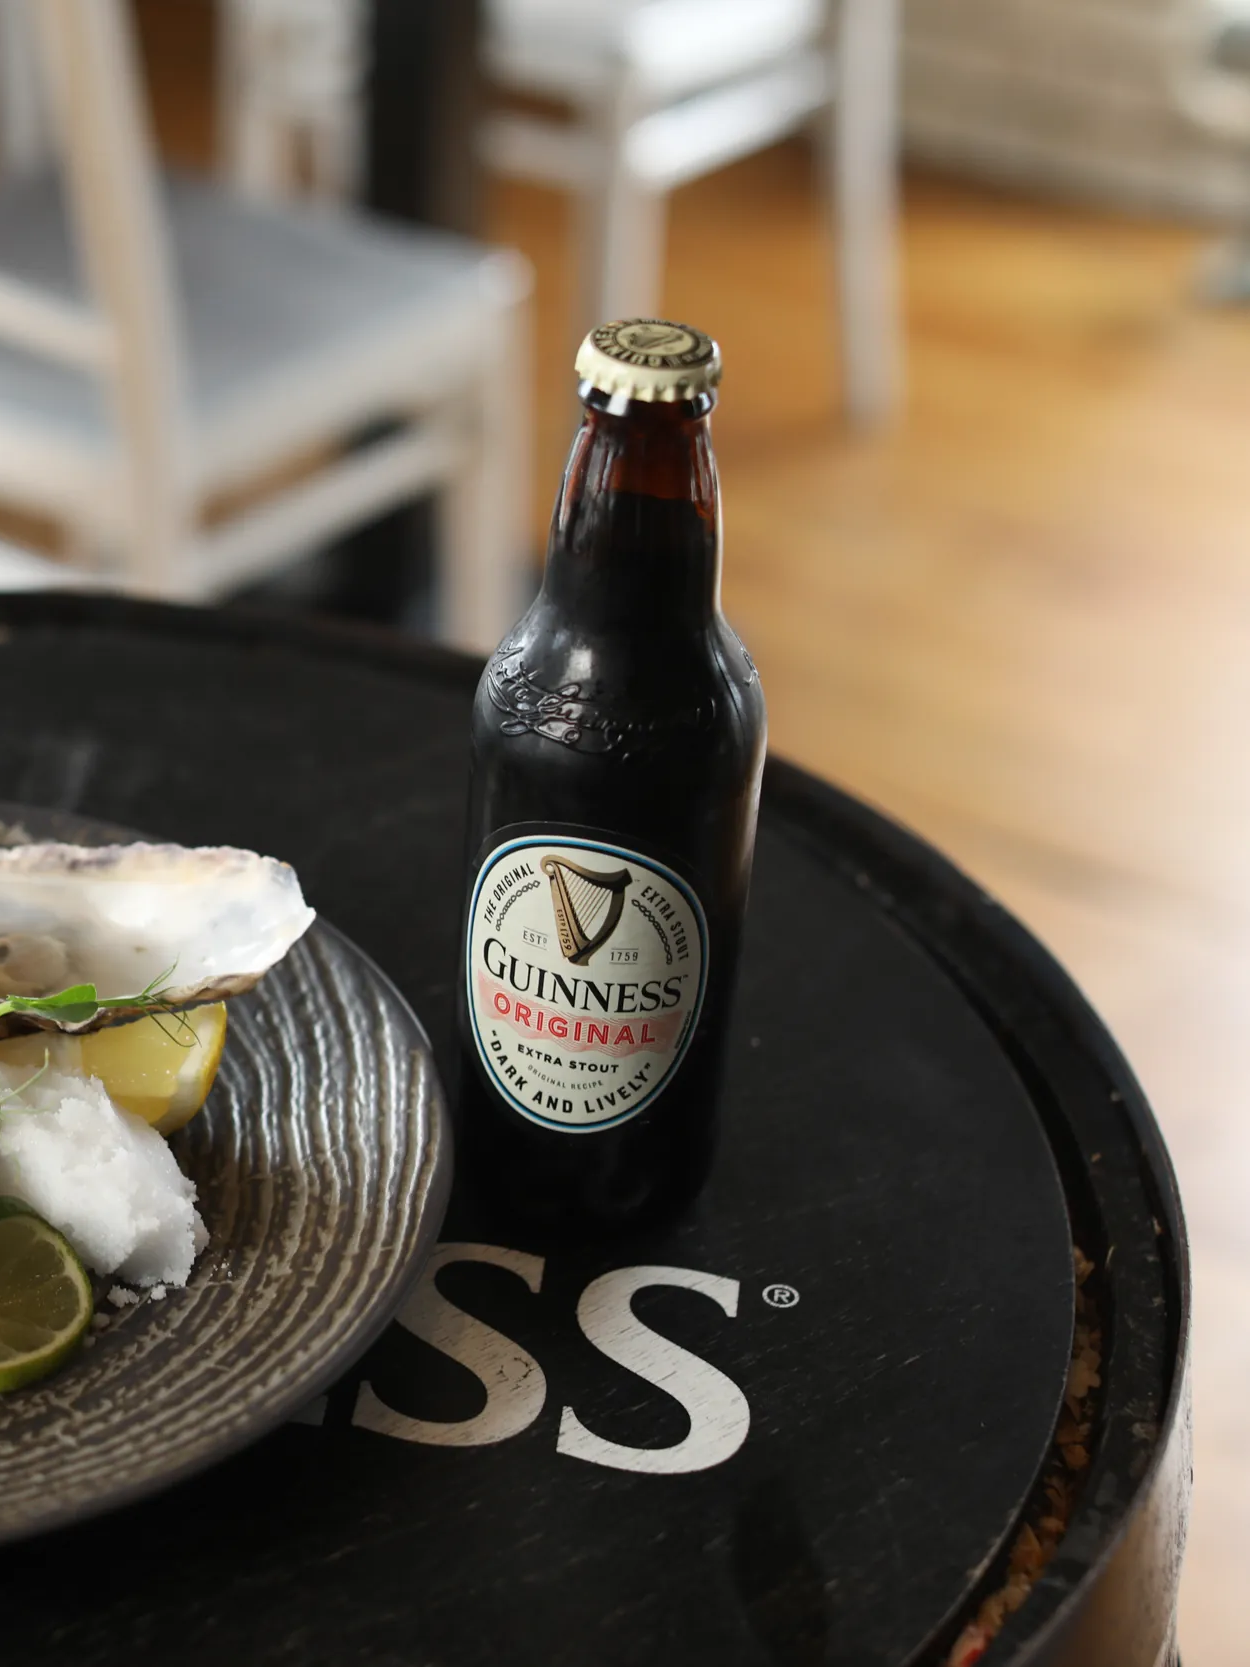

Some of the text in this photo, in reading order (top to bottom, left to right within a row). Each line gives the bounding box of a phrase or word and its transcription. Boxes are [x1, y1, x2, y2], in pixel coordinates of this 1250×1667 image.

[483, 863, 534, 924] THE ORIGINAL
[640, 885, 689, 962] EXTRA STOUT
[483, 937, 684, 1013] GUINNESS
[610, 951, 639, 961] 1759
[494, 993, 656, 1045] ORIGINAL
[517, 1043, 619, 1073] EXTRA STOUT
[527, 1064, 604, 1091] ORIGINAL RECIPE
[531, 1090, 573, 1114] AND
[287, 1242, 751, 1475] SS
